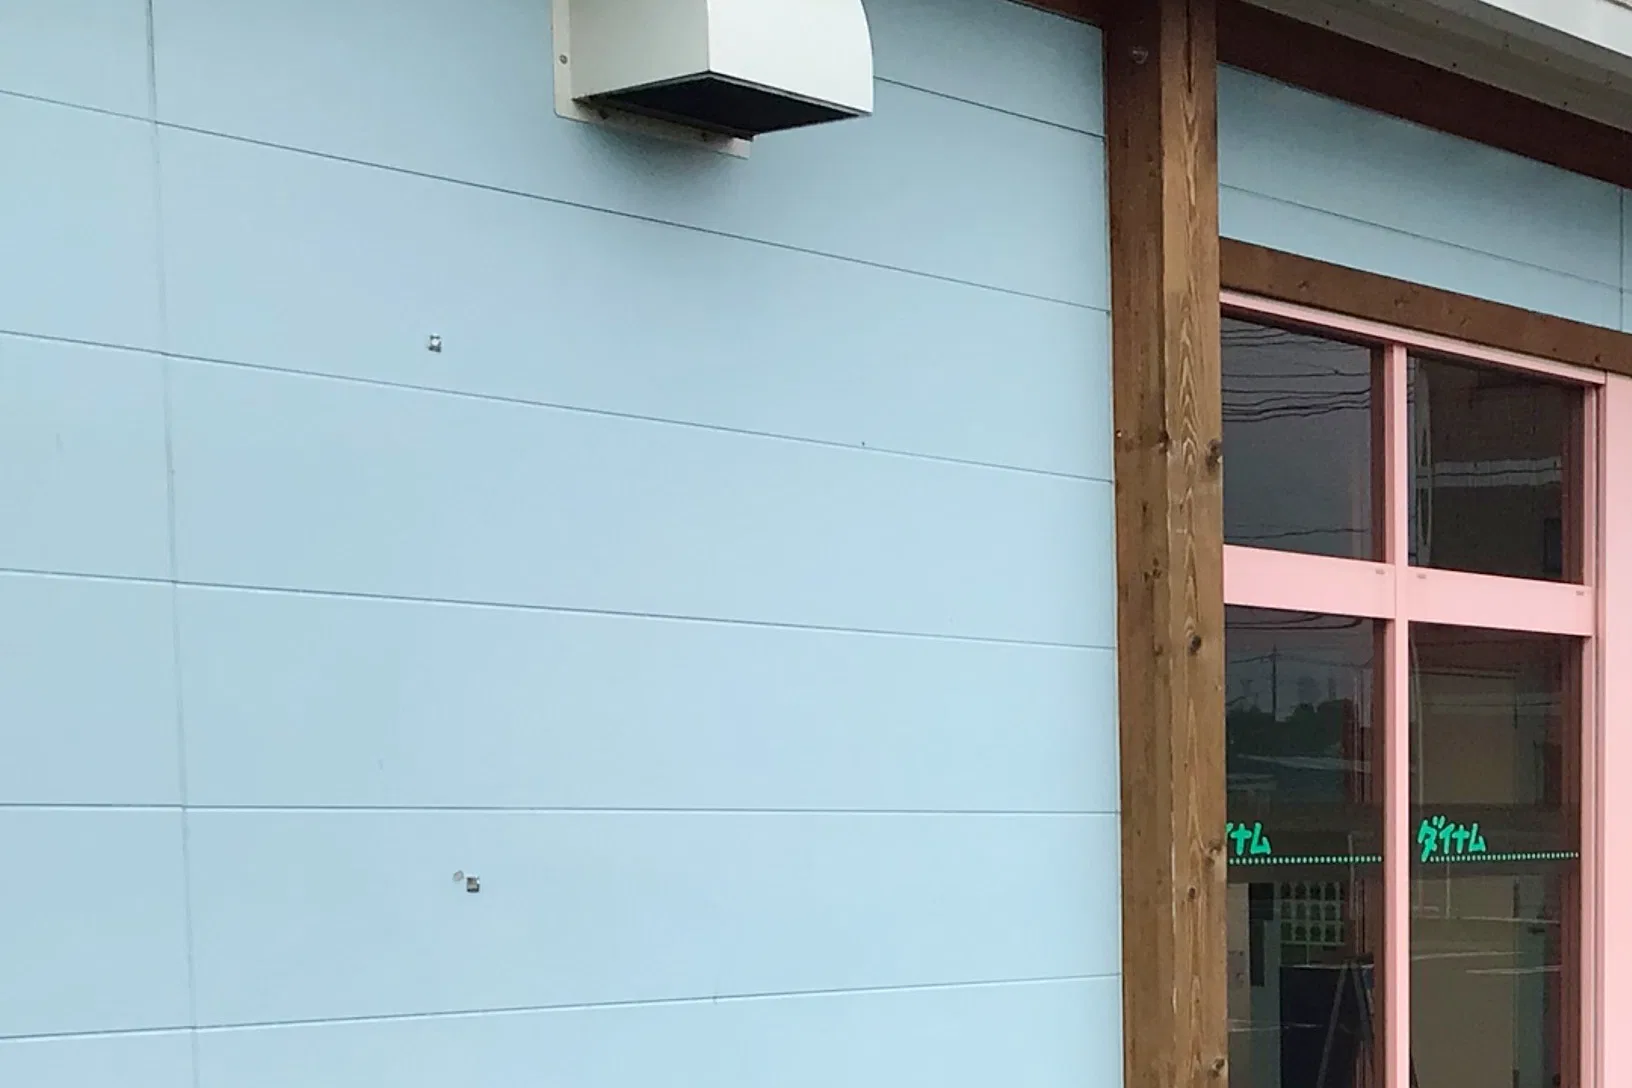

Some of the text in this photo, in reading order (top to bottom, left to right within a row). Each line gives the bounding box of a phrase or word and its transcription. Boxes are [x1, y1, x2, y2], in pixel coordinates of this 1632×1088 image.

[1226, 822, 1271, 855] ナム
[1417, 815, 1486, 862] ダイナム
